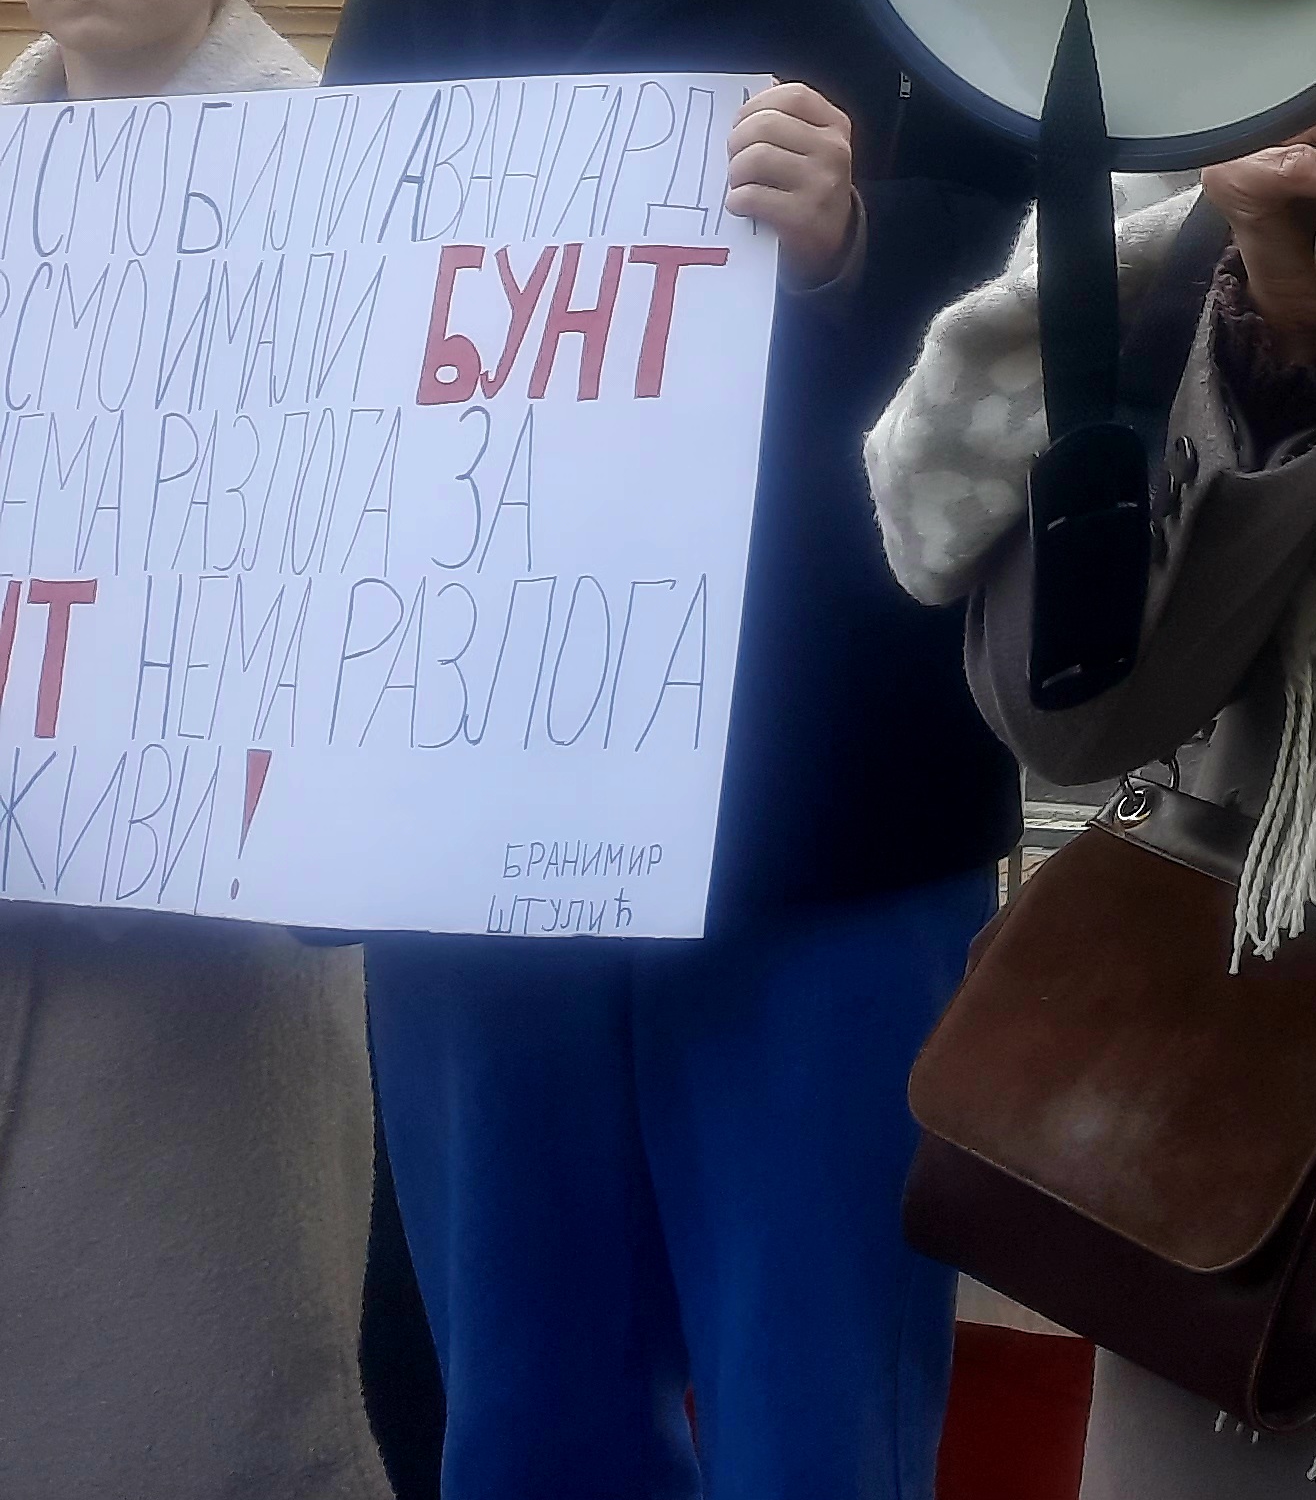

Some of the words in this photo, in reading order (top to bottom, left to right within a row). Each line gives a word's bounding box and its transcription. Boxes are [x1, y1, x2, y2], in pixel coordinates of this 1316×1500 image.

[177, 90, 402, 256] БИЛИ
[155, 249, 387, 414] ИМАЛИ
[415, 242, 731, 406] БУНТ
[0, 409, 125, 577] ЕМА
[144, 406, 402, 578] РАЗЛОГА
[431, 402, 534, 575] ЗА
[131, 573, 313, 748] НЕМА
[328, 573, 709, 753] РАЗЛОГА
[501, 839, 664, 880] БРАНИМИР
